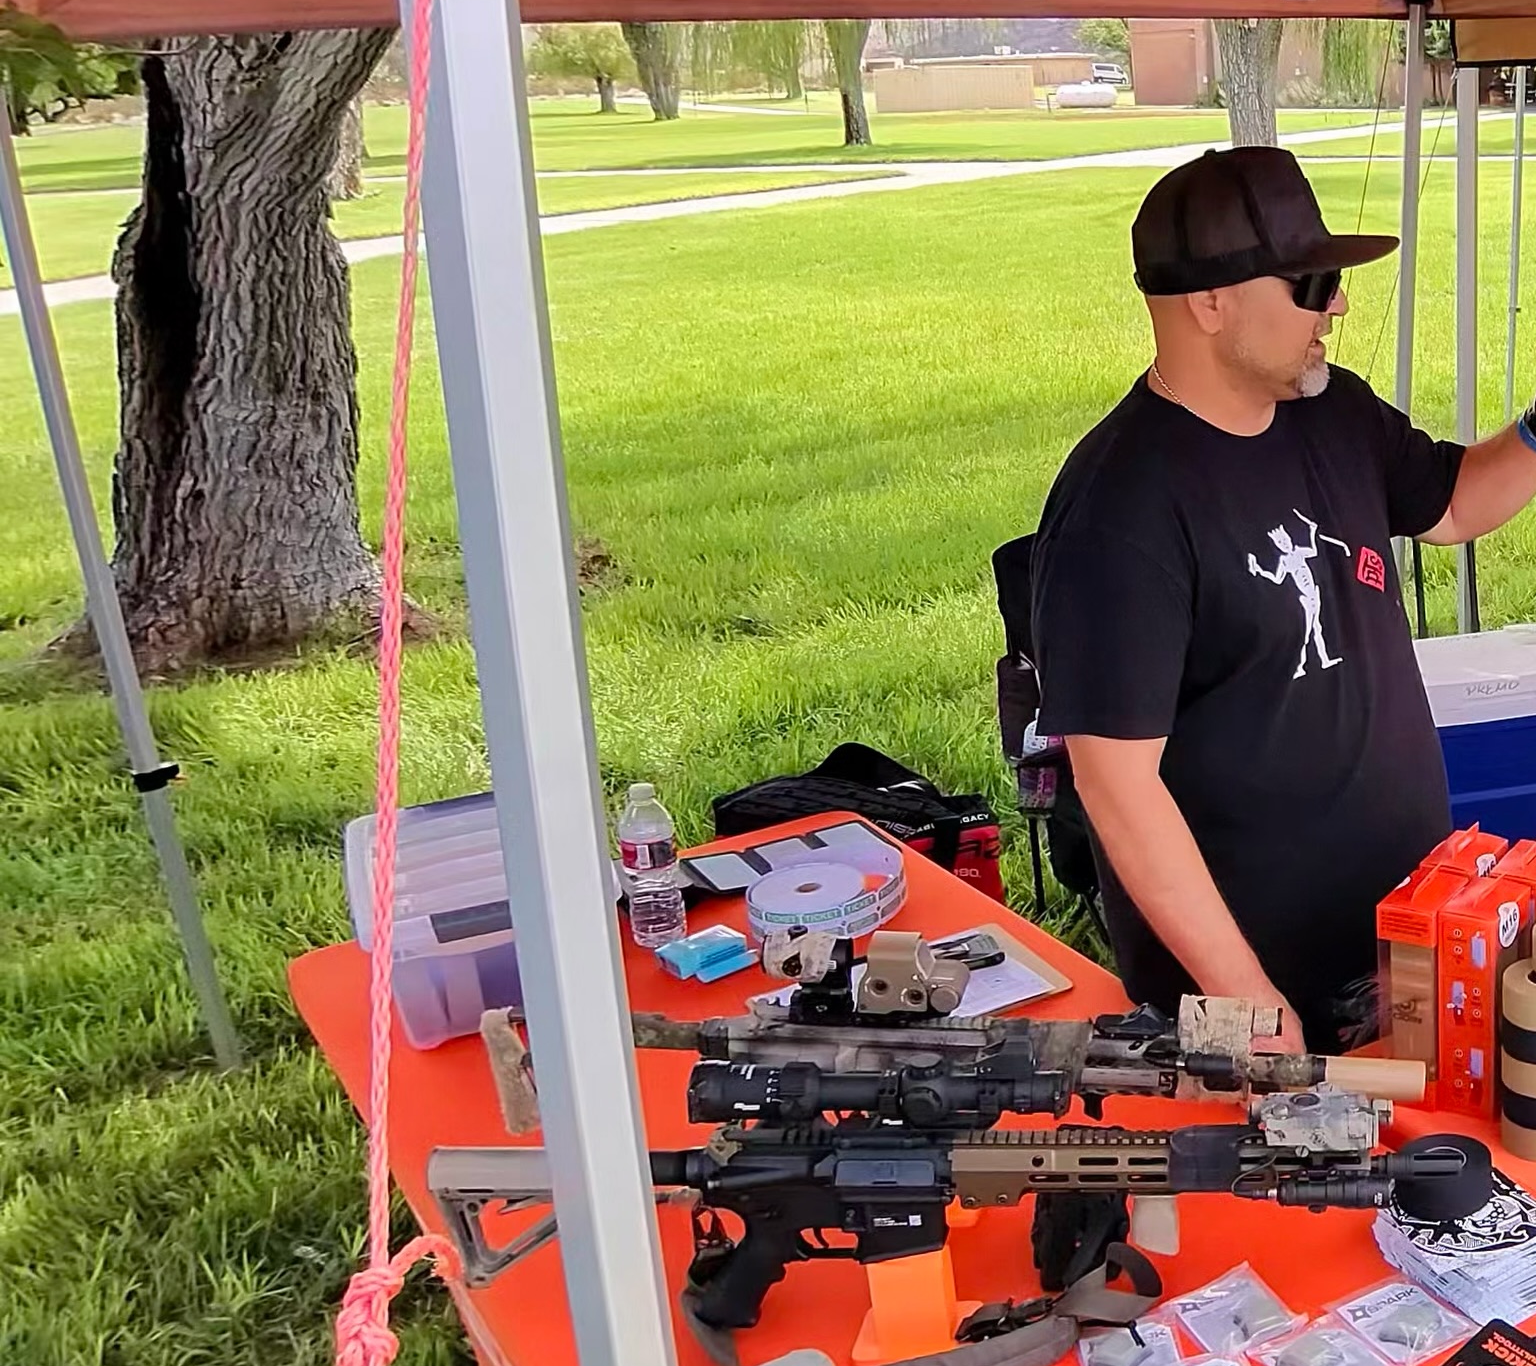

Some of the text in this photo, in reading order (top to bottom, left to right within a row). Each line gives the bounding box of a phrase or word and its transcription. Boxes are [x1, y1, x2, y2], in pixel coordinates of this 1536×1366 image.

[803, 909, 841, 925] TICKET
[845, 895, 876, 916] TICKET
[1501, 908, 1518, 937] M16
[1366, 1286, 1419, 1318] SPARK
